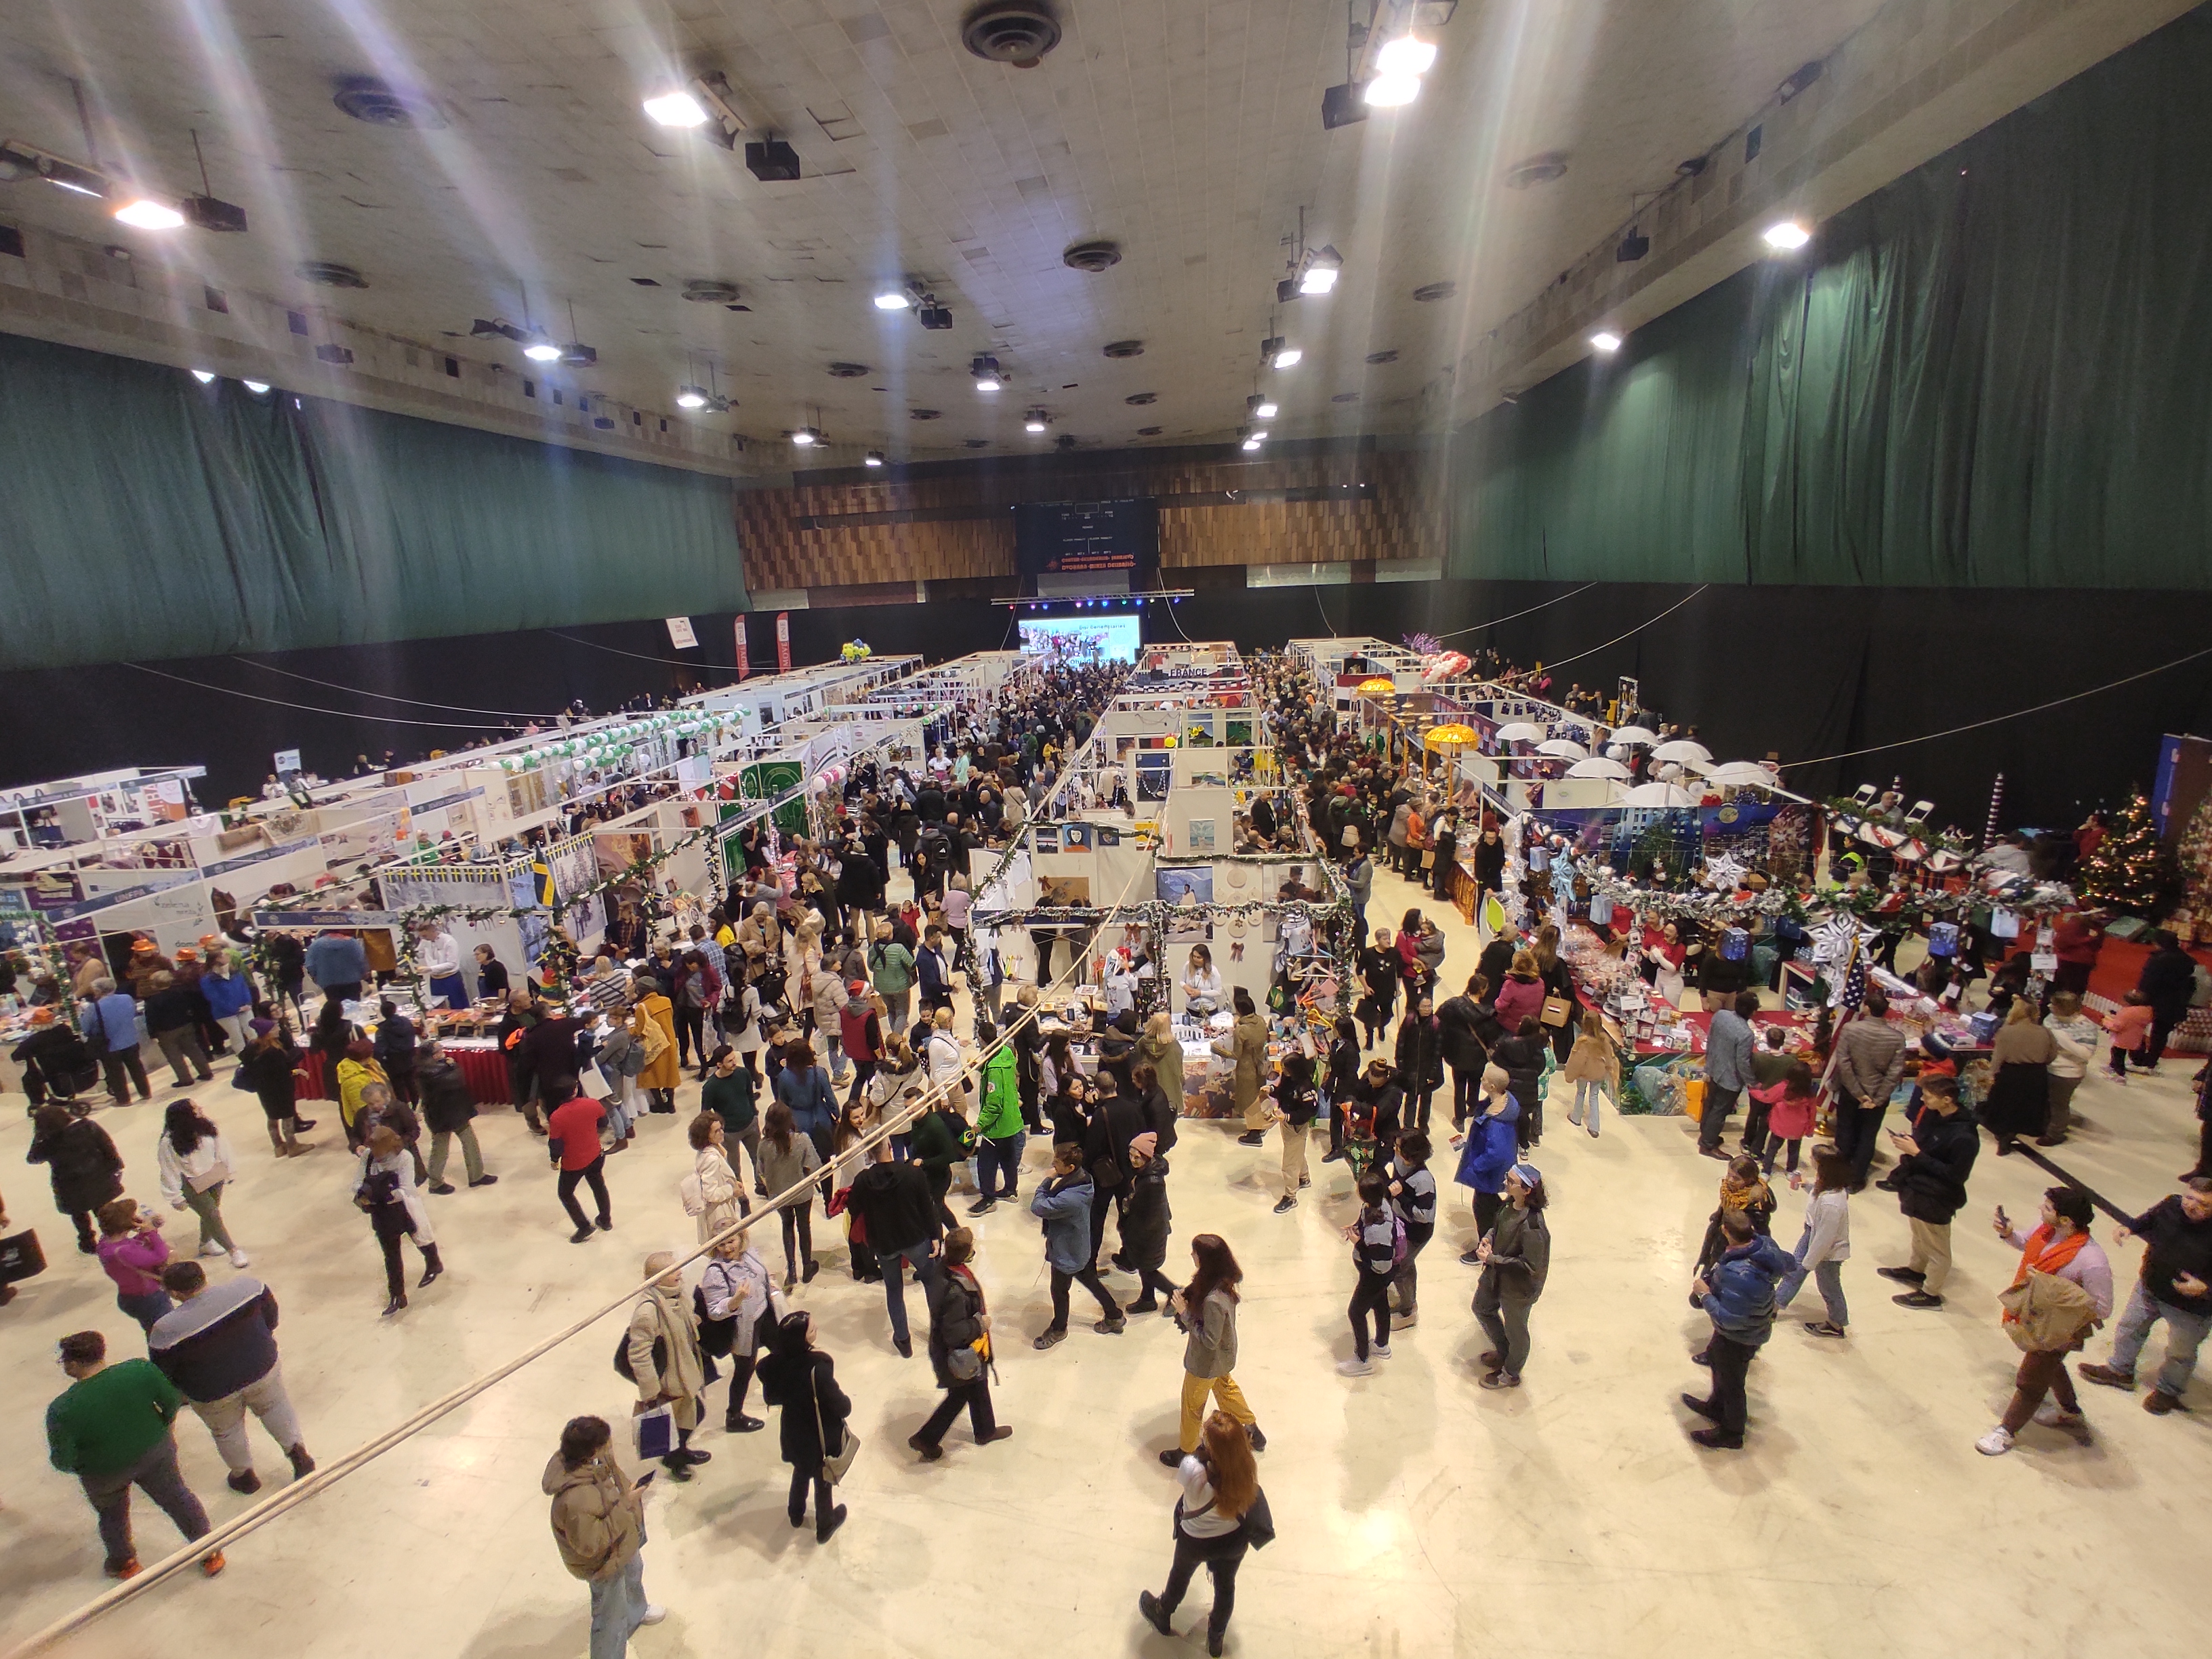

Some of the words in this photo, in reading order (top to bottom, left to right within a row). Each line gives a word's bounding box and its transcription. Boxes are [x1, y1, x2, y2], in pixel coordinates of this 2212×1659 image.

[781, 642, 789, 667] MOVE
[1170, 668, 1208, 678] FRANCE
[115, 888, 146, 903] UNFPA
[312, 915, 348, 924] SWEDEN
